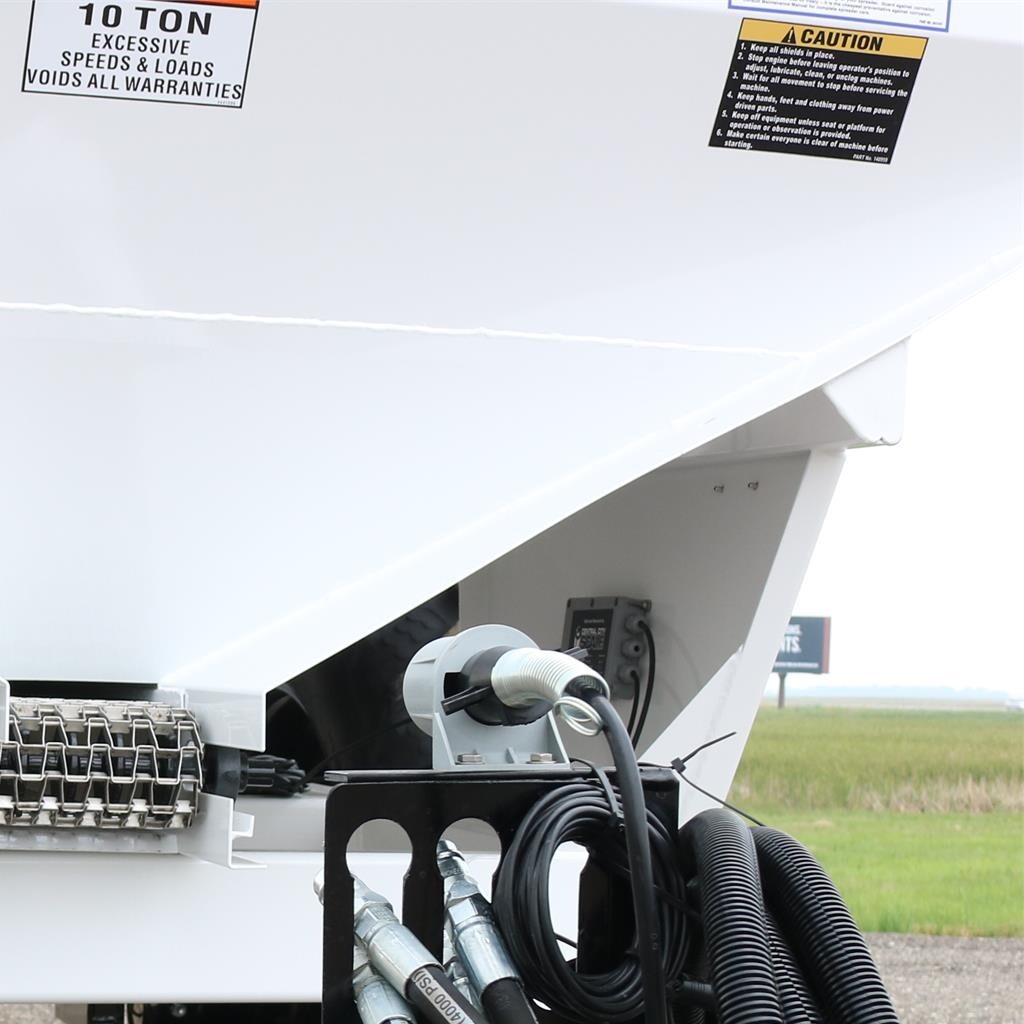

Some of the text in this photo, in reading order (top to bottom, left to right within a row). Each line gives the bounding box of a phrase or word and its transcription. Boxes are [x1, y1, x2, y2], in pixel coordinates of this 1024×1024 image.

[79, 3, 212, 35] 10 TON
[91, 33, 191, 56] EXCESSIVE
[741, 42, 747, 50] 1.
[750, 43, 768, 54] Keep
[780, 48, 804, 56] shields
[814, 51, 835, 59] place.
[801, 28, 883, 52] CAUTION
[61, 51, 214, 78] SPEEDS & LOADS
[737, 52, 744, 60] 2.
[748, 53, 763, 62] Stop
[765, 56, 787, 65] engine
[789, 58, 811, 67] before
[813, 60, 838, 71] leaving
[839, 64, 873, 74] operator's
[874, 67, 901, 76] position
[745, 64, 768, 73] adjust,
[770, 66, 802, 77] lubricate,
[804, 69, 825, 79] clean,
[836, 73, 858, 83] unclog
[860, 76, 893, 86] machines.
[27, 68, 242, 100] VOIDS ALL WARRANTIES
[732, 71, 738, 79] 3.
[742, 72, 757, 81] Wait
[759, 74, 769, 82] for
[770, 75, 780, 83] all
[781, 77, 816, 87] movement
[826, 81, 840, 90] stop
[842, 83, 864, 92] before
[865, 86, 896, 97] servicing
[897, 89, 908, 97] the
[740, 84, 770, 92] machine.
[735, 102, 777, 112] driven parts.
[737, 92, 754, 102] Keep
[756, 94, 777, 104] hands,
[779, 96, 794, 104] feet
[795, 98, 808, 106] and
[809, 100, 837, 111] clothing
[837, 103, 856, 112] away
[857, 104, 872, 113] from
[873, 107, 894, 115] power
[721, 110, 728, 118] 5.
[732, 111, 749, 121] Keep
[750, 113, 761, 121] off
[761, 114, 797, 124] equipment
[798, 118, 820, 127] unless
[821, 120, 837, 129] seat
[846, 123, 875, 132] platform
[876, 126, 886, 134] for
[729, 122, 851, 140] operation or observation is provided.
[724, 140, 753, 149] starting.
[727, 129, 744, 138] Make
[745, 132, 770, 141] certain
[771, 135, 802, 145] everyone
[811, 138, 829, 146] clear
[838, 142, 866, 151] machine
[867, 144, 888, 153] before
[412, 969, 438, 996] PSI)
